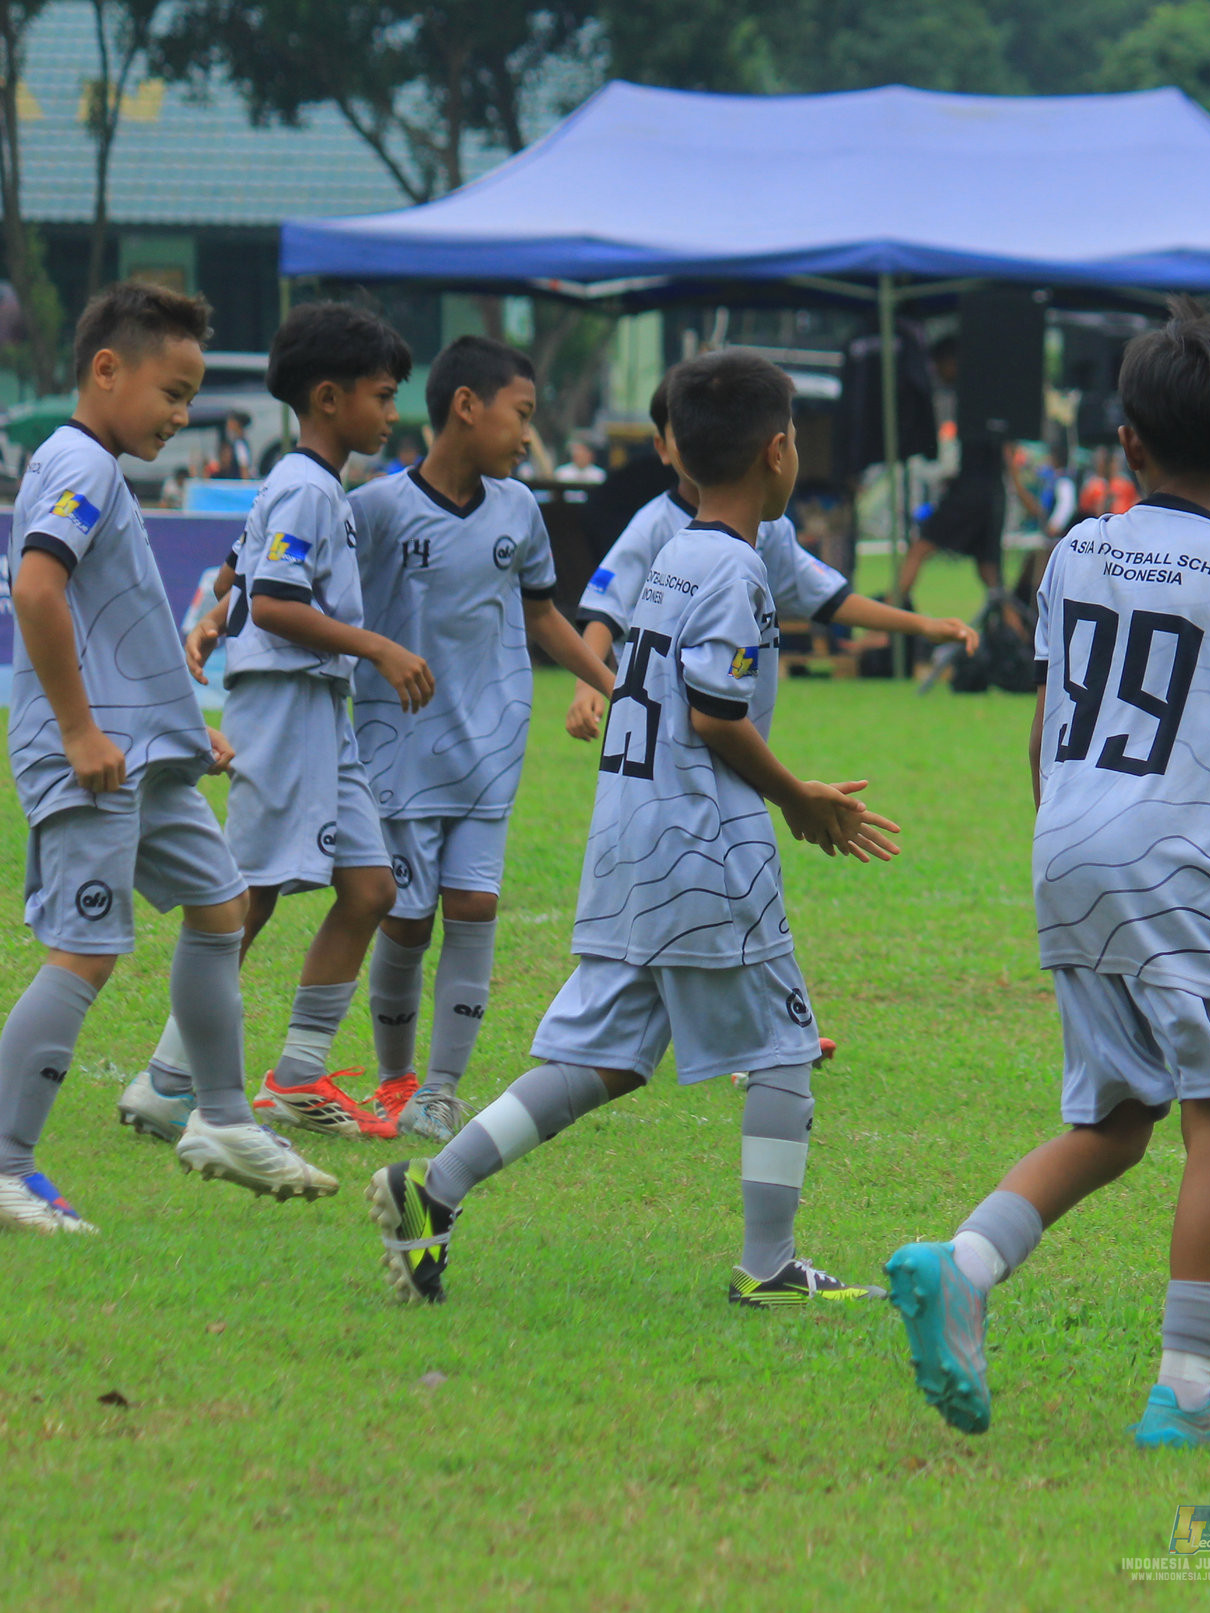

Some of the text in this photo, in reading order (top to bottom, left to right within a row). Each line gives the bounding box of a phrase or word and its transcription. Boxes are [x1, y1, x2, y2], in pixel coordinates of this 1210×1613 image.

[402, 538, 431, 569] 14
[1070, 539, 1095, 555] ASIA
[664, 574, 699, 597] SCHOO
[1054, 598, 1205, 777] 99
